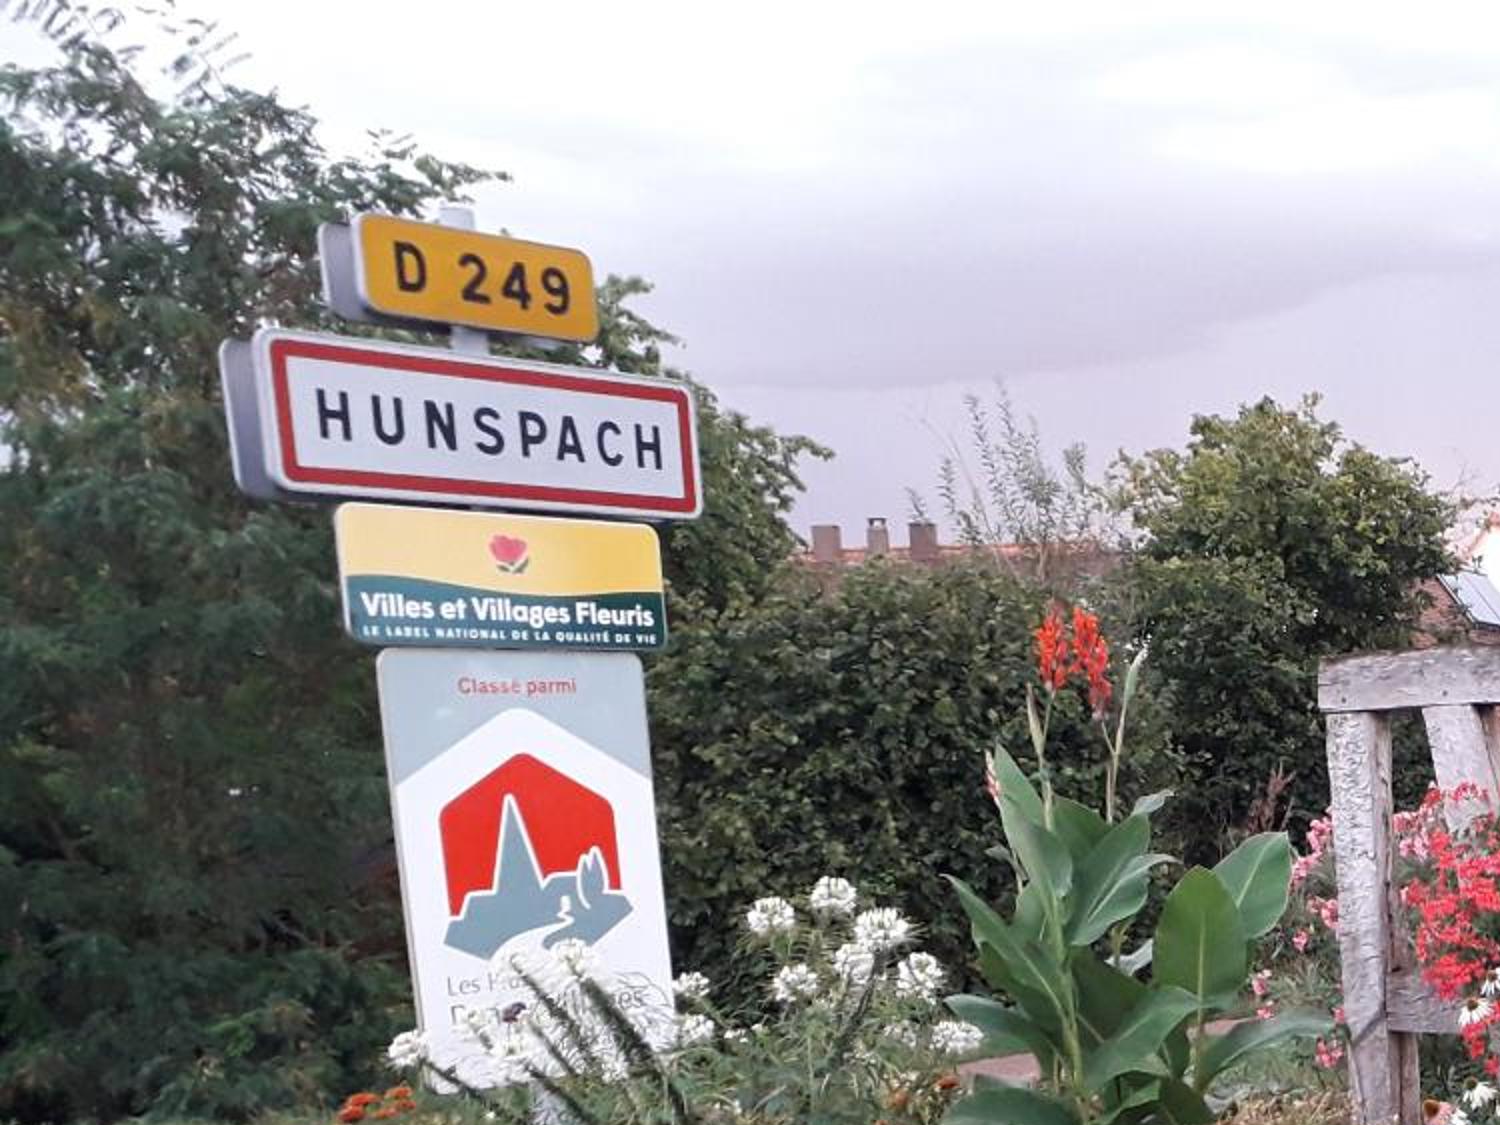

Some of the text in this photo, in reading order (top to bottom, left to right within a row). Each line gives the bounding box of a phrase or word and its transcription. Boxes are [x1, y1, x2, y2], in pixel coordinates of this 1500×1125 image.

[393, 240, 571, 315] D 249
[315, 387, 664, 471] HUNSPACH
[359, 591, 655, 629] Villes et Villages Fleuris
[362, 625, 657, 645] LE LABEL NATIONAL DE LA QUALITÉ DE VIE
[527, 678, 577, 698] parmi
[447, 975, 482, 997] Les
